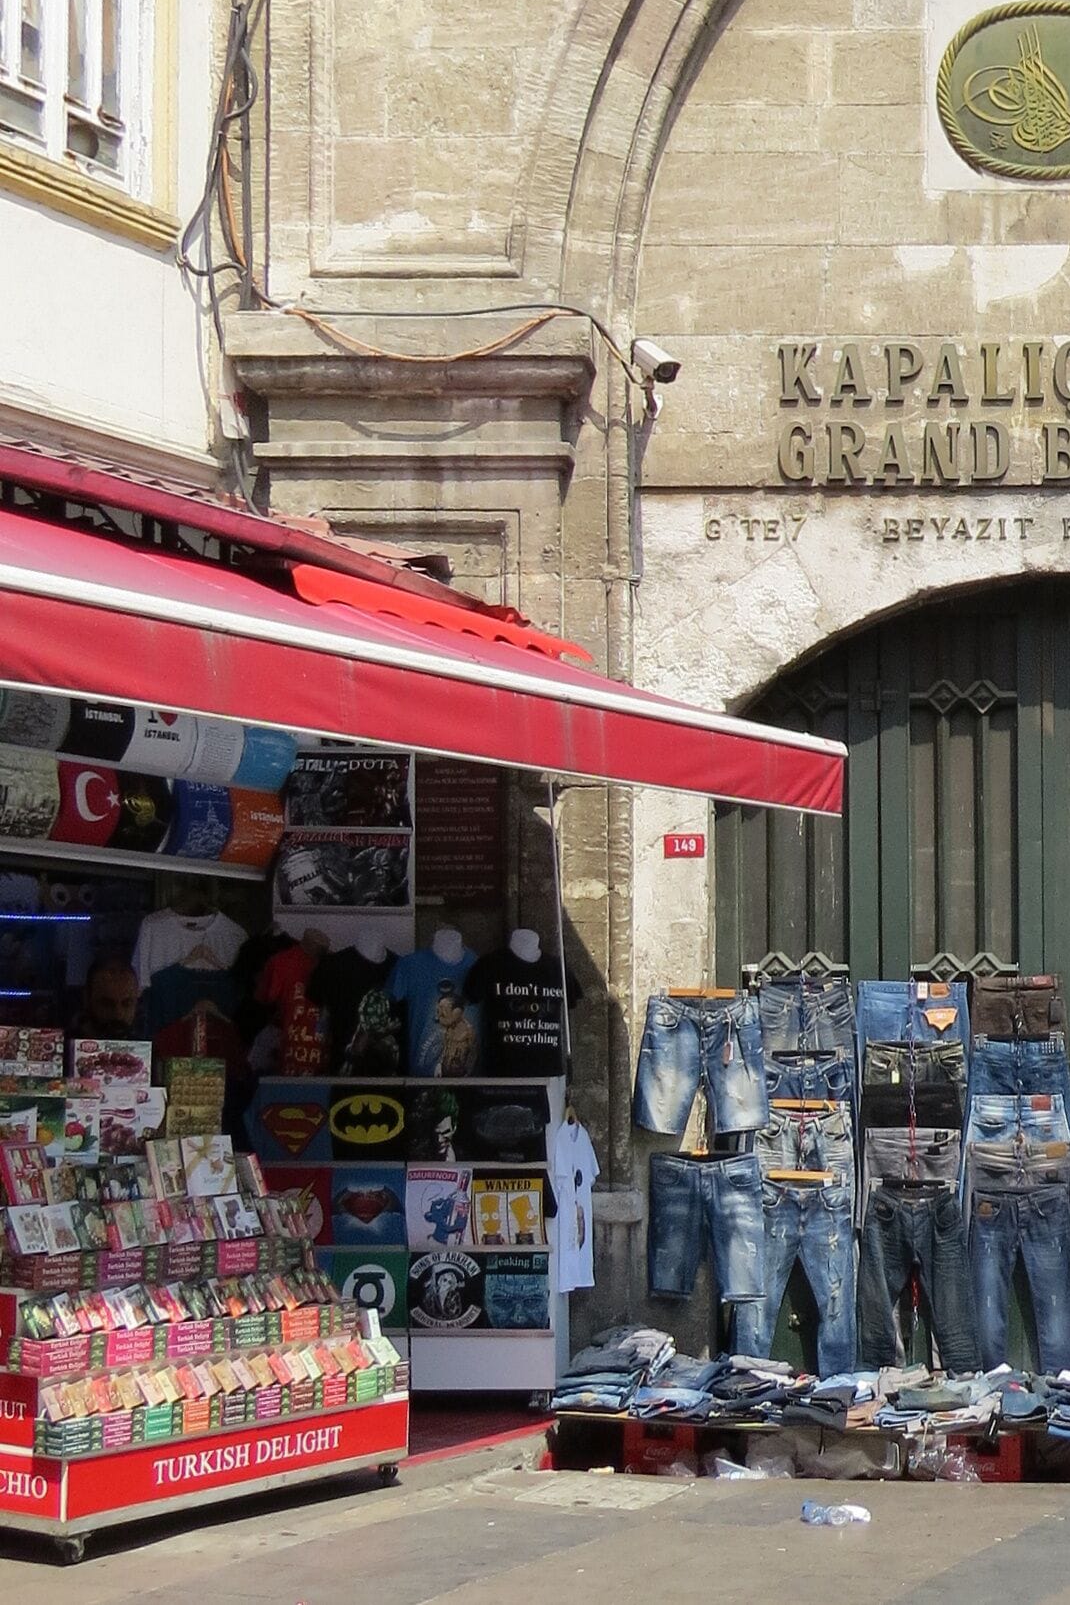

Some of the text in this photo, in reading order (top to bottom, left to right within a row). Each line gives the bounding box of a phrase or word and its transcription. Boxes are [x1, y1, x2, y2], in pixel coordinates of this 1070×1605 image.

[778, 420, 1011, 482] GRAND
[705, 513, 808, 542] GTE 7
[883, 515, 1035, 542] BEYAZIT
[349, 758, 399, 771] DOTA
[674, 838, 697, 853] 149
[515, 1017, 537, 1031] wife
[503, 1032, 559, 1048] everything
[485, 1179, 531, 1191] WANTED
[153, 1425, 343, 1485] TURKISH DELIGHT
